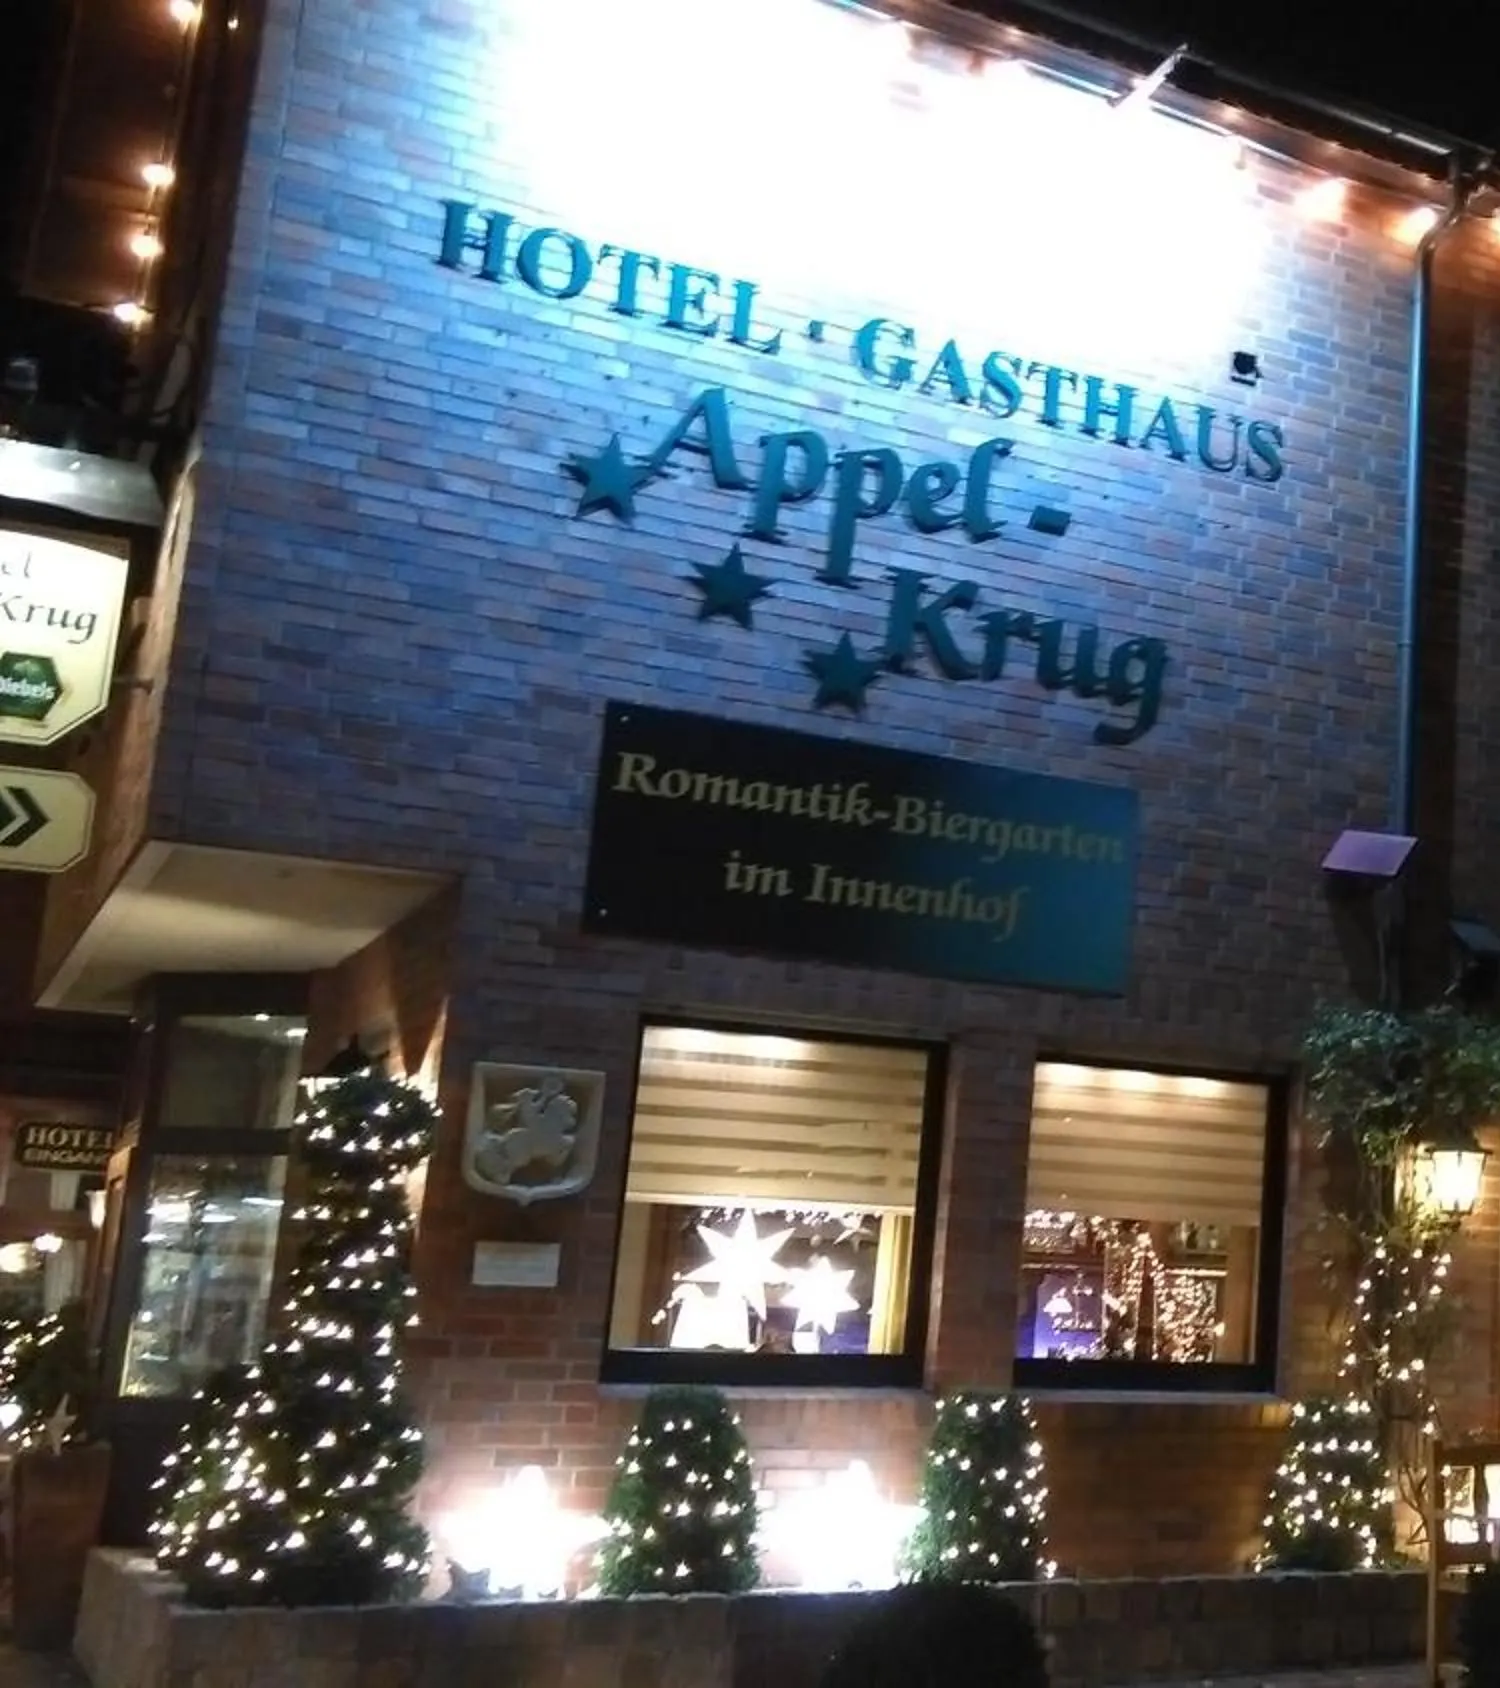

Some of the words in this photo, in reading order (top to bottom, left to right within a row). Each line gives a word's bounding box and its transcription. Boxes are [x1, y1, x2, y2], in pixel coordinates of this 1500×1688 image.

[435, 201, 781, 355] HOTEL
[855, 316, 1286, 484] GASTHAUS
[880, 564, 1173, 747] Krug
[613, 750, 1125, 865] Romantik-Biergarten
[724, 849, 793, 897] im
[805, 861, 1031, 942] Innenhof
